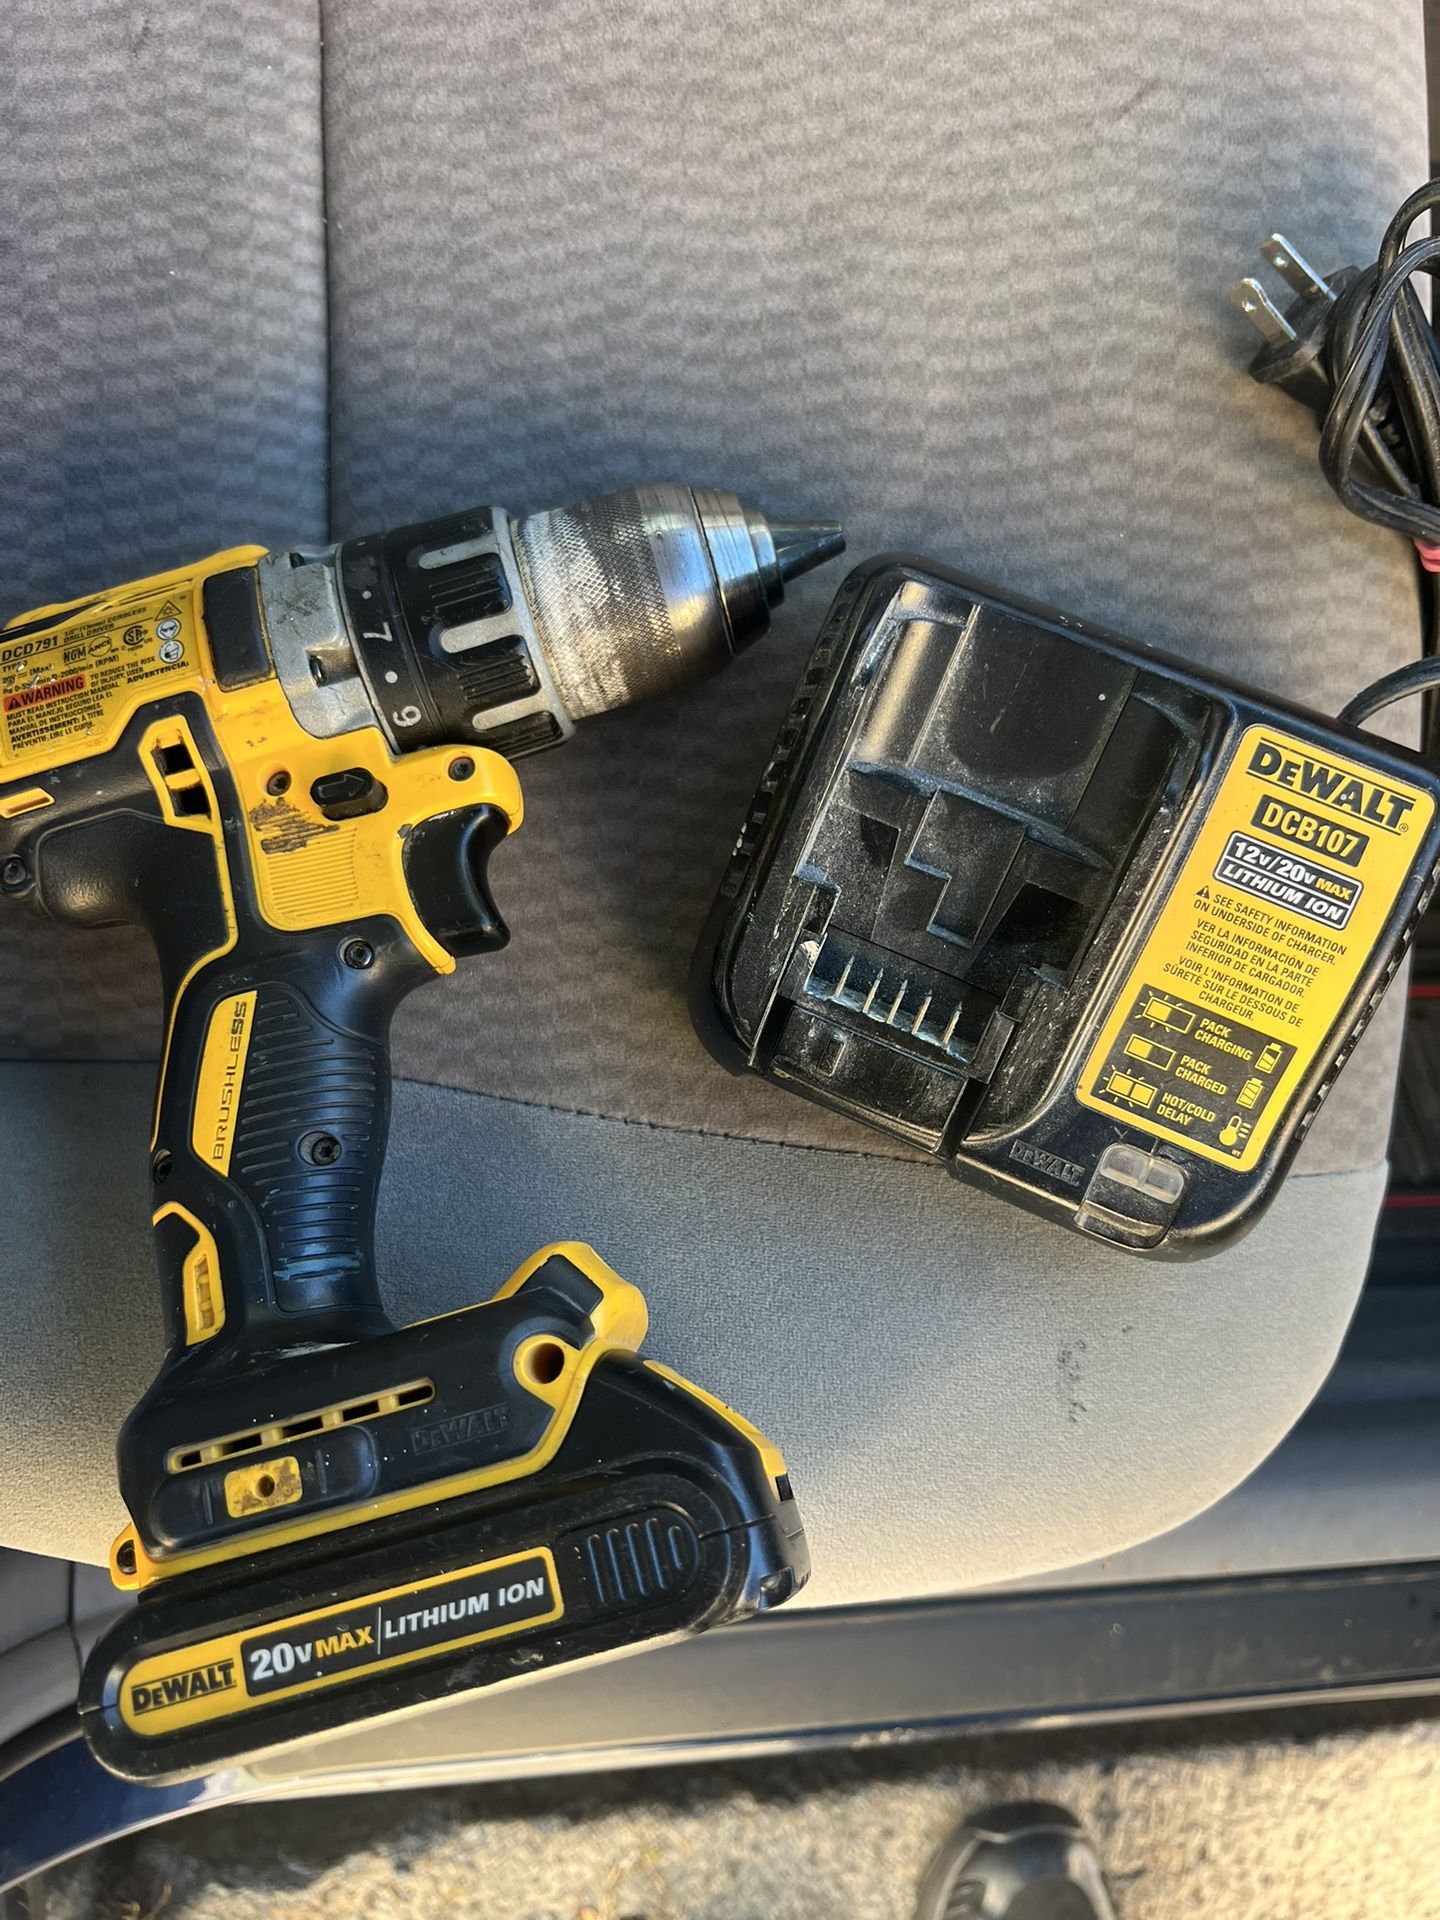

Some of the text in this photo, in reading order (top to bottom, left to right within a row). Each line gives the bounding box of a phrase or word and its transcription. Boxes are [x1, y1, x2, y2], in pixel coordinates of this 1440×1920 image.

[107, 607, 147, 622] CORDLESS
[64, 624, 114, 644] DRILL DRIVER
[363, 622, 393, 642] 7
[2, 635, 58, 661] DCD791
[96, 655, 120, 667] (RPM)
[100, 666, 126, 678] REDUCE
[126, 661, 140, 670] THE
[140, 656, 156, 666] RISK
[126, 666, 144, 676] USER
[6, 710, 26, 721] MUST
[26, 705, 44, 715] READ
[46, 692, 90, 709] INSTRUCTION
[126, 661, 190, 684] ADVERTENCIA:
[21, 676, 84, 706] WARNING
[8, 718, 26, 728] PARA
[36, 707, 64, 720] MANEJO
[65, 699, 92, 713] SEGURO
[92, 694, 106, 704] LEA
[11, 718, 80, 744] AVERTISSEMENT:
[88, 709, 104, 718] TITRE
[10, 722, 38, 736] MANUAL
[50, 731, 64, 740] LIRE
[64, 728, 73, 736] LE
[1262, 802, 1359, 858] DCB107
[1222, 864, 1344, 922] LITHIUM ION
[1316, 878, 1353, 900] MAX
[1194, 900, 1336, 966] ON UNDERSIDE OF CHARGER.
[1213, 894, 1347, 956] SEE SAFETY INFORMATION
[1190, 930, 1314, 988] SEGURIDAD EN LA PARTE
[1198, 918, 1320, 977] VER LA INFORMACIÓN DE
[1178, 956, 1300, 1014] VOIR L'INFORMATION DE
[1186, 941, 1305, 998] INFERIOR DE CARGADOR.
[1198, 990, 1254, 1021] CHARGEUR.
[1202, 980, 1224, 996] SUR
[1225, 988, 1238, 1001] LE
[1238, 993, 1288, 1021] DESSOUS
[1288, 1016, 1304, 1028] DE
[1200, 1018, 1232, 1038] PACK
[1194, 1030, 1253, 1062] CHARGING
[212, 1001, 247, 1160] BRUSHLESS
[1180, 1054, 1213, 1076] PACK
[1175, 1066, 1228, 1096] CHARGED
[1156, 1104, 1193, 1126] DELAY
[1162, 1092, 1216, 1123] HOT/COLD
[384, 1576, 546, 1640] LITHIUM ION
[315, 1625, 374, 1659] MAX
